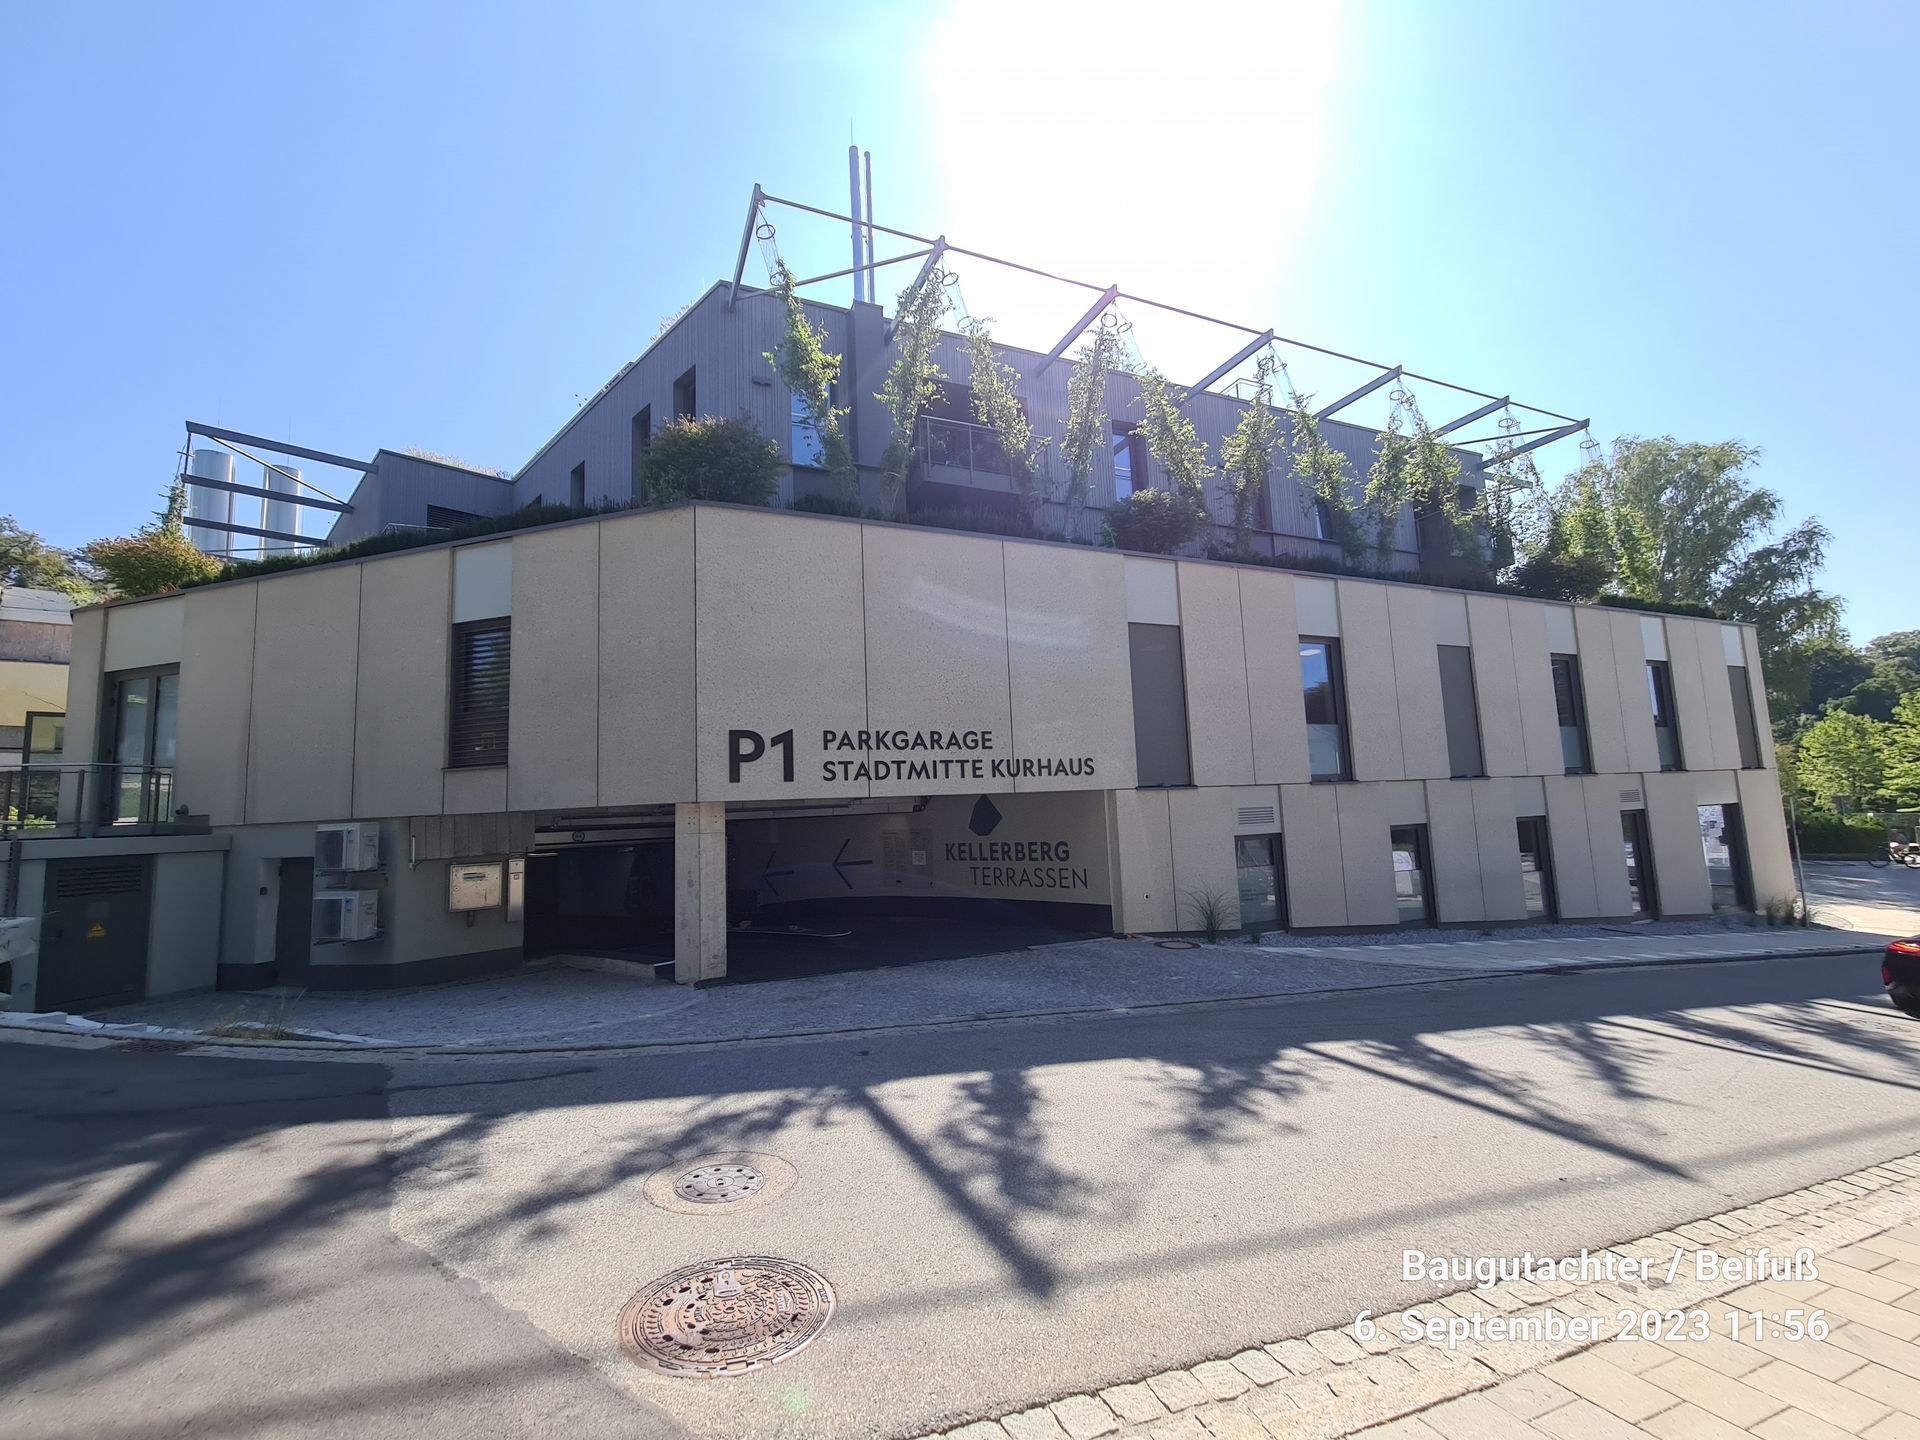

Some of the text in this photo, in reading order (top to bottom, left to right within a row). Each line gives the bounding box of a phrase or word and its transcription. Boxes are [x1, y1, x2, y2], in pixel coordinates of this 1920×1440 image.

[822, 729, 994, 752] PARKGARAGE
[728, 728, 796, 783] P1
[822, 757, 1096, 782] STADTMITTE KURHAUS
[944, 840, 1071, 863] KELLERBERG
[969, 865, 1090, 891] TERRASSEN
